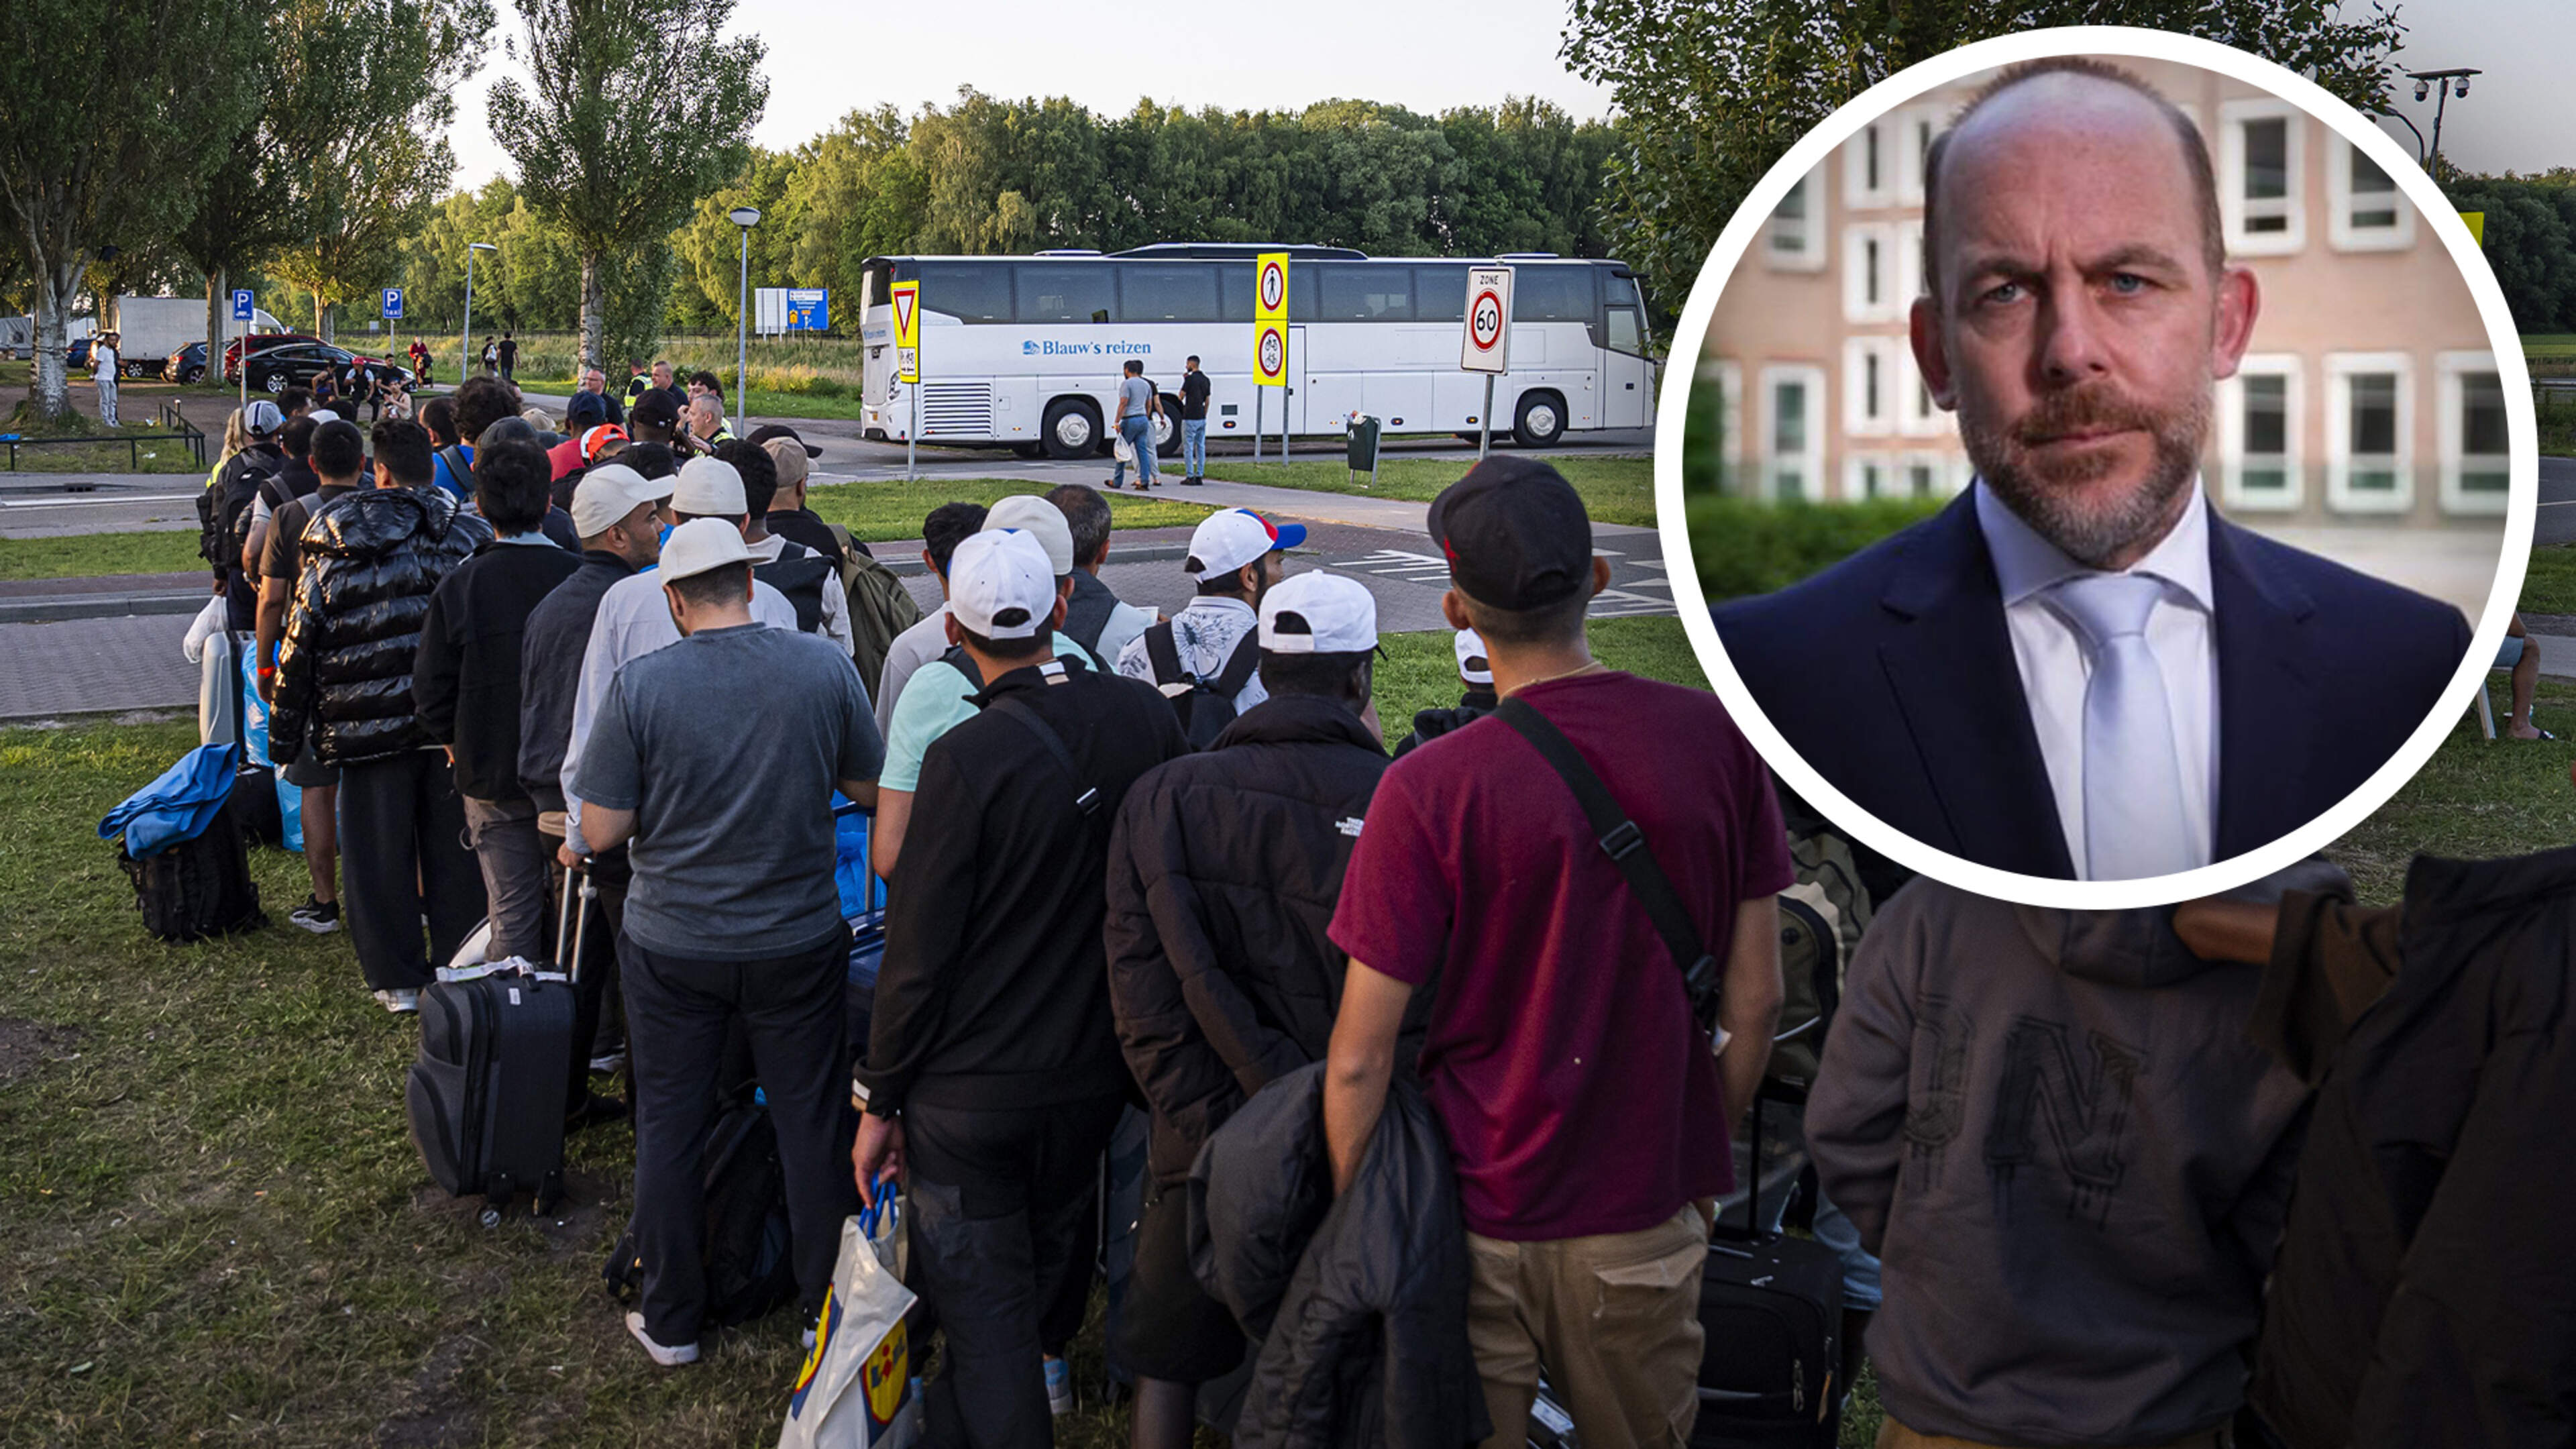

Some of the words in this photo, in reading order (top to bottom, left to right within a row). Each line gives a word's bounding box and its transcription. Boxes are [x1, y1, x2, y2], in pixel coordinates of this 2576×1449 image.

[1480, 275, 1499, 285] ZONE
[237, 293, 249, 308] P
[387, 292, 398, 307] P
[1477, 309, 1497, 331] 60
[1042, 340, 1102, 355] Blauw's
[1106, 339, 1151, 354] reizen
